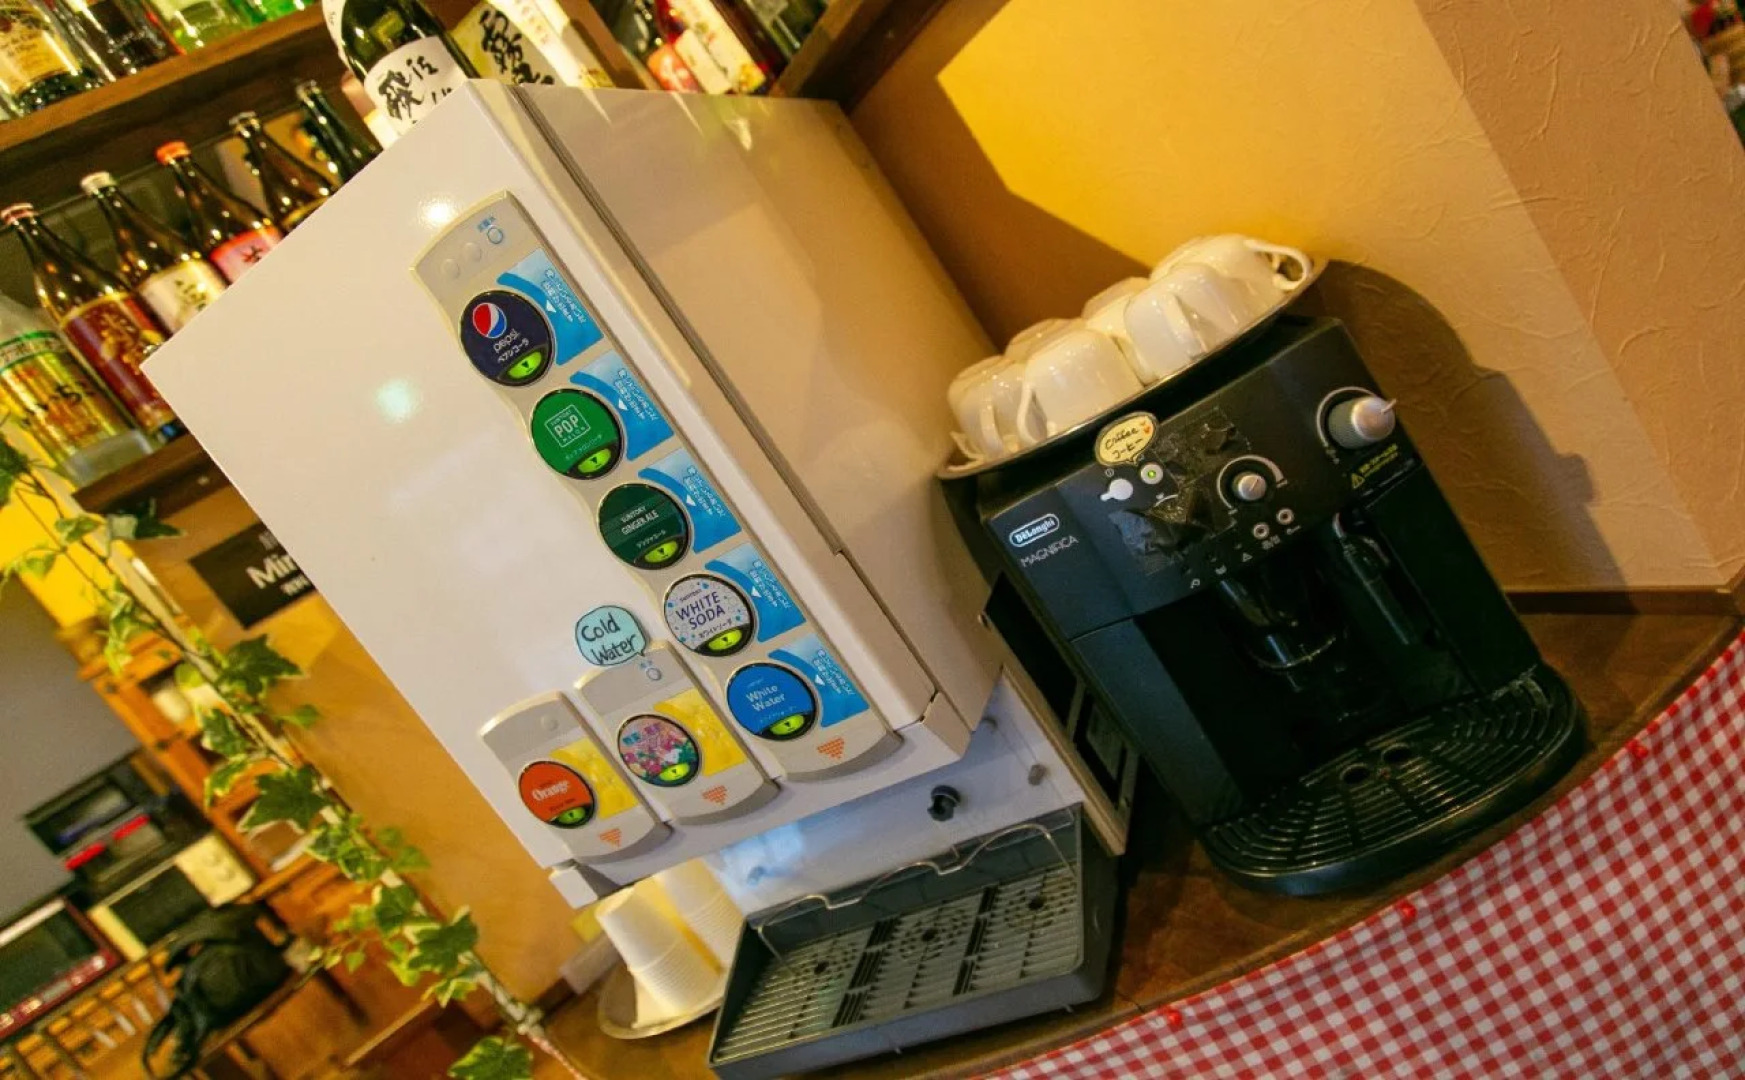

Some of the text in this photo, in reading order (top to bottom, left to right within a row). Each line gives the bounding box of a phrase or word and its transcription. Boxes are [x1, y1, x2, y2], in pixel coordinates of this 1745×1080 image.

[493, 328, 520, 353] pepsi
[553, 413, 579, 439] POP
[1105, 427, 1139, 450] Coffee
[621, 517, 648, 535] GINGER
[1019, 535, 1080, 568] MAGNIFICA
[675, 591, 721, 621] WHITE
[688, 604, 726, 630] SODA
[581, 612, 621, 642] Cold
[591, 633, 637, 664] Water
[746, 685, 779, 703] White
[752, 693, 786, 713] Water
[531, 780, 570, 801] Orange
